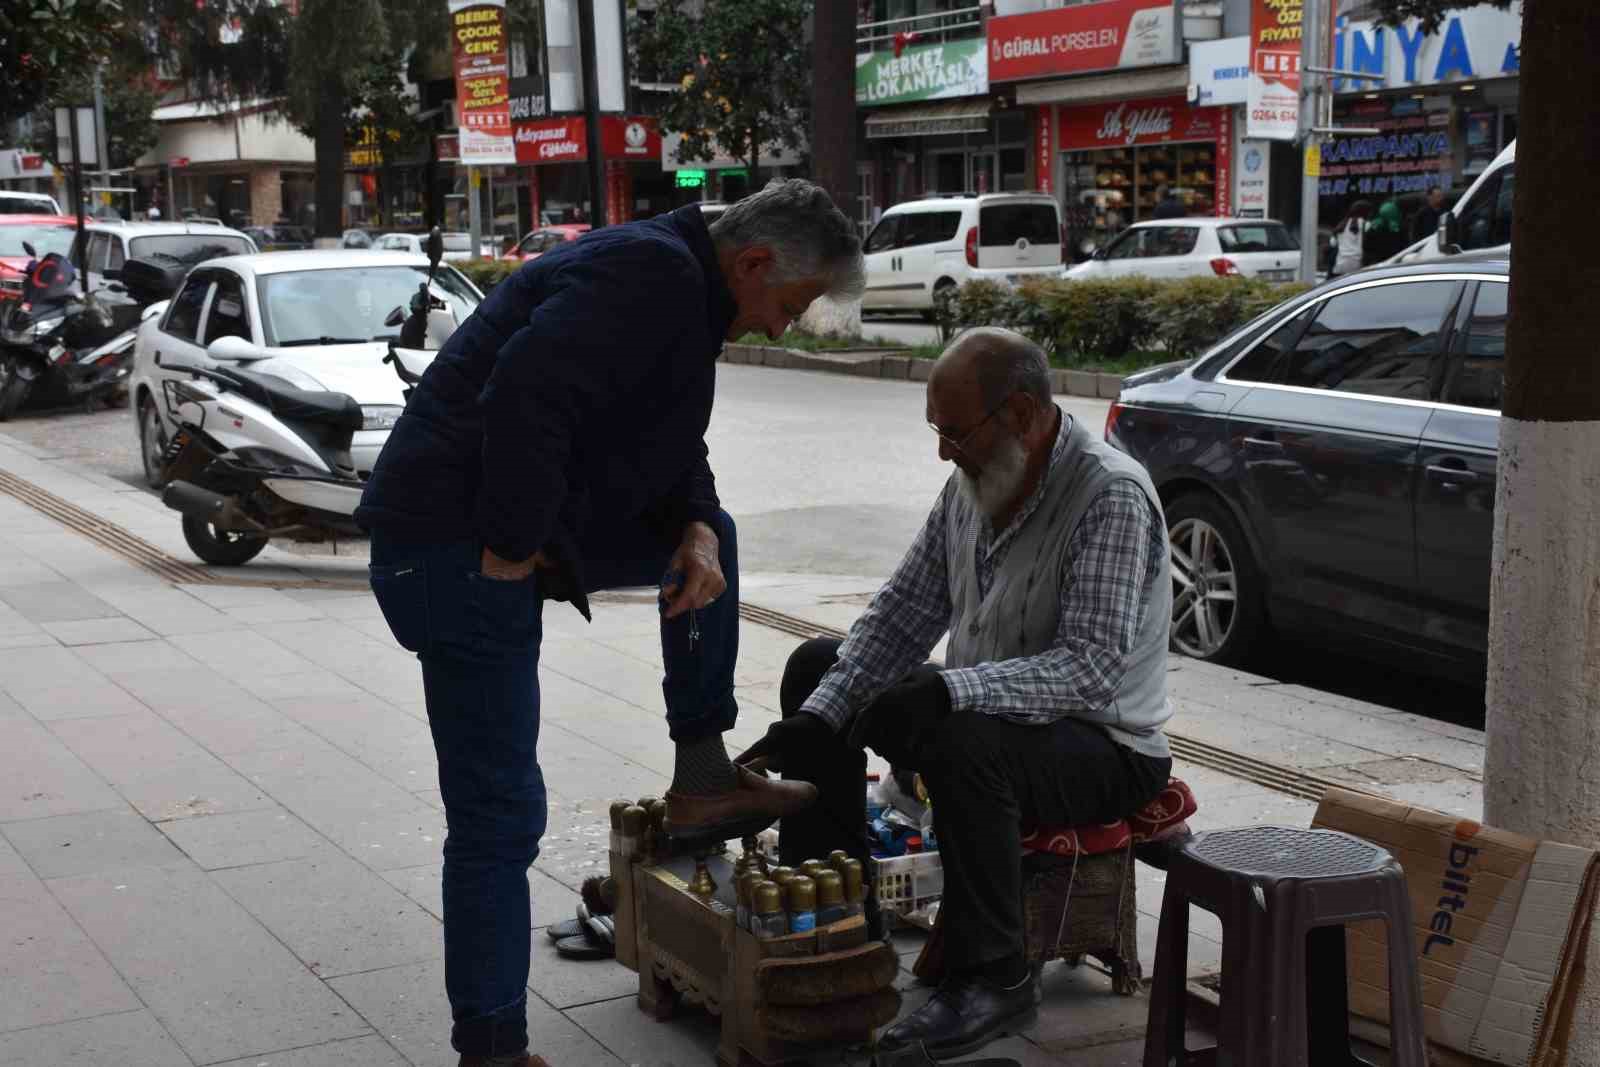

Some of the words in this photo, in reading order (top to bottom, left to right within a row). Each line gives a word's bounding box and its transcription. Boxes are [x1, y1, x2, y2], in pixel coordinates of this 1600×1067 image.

[455, 10, 498, 25] BEBEK
[457, 25, 502, 42] ÇOCUK
[1003, 36, 1050, 59] GÜRAL
[1051, 28, 1119, 52] PORSELEN
[465, 41, 499, 54] GENÇ
[877, 48, 944, 80] MERKEZ
[867, 63, 964, 100] LOKANTASI
